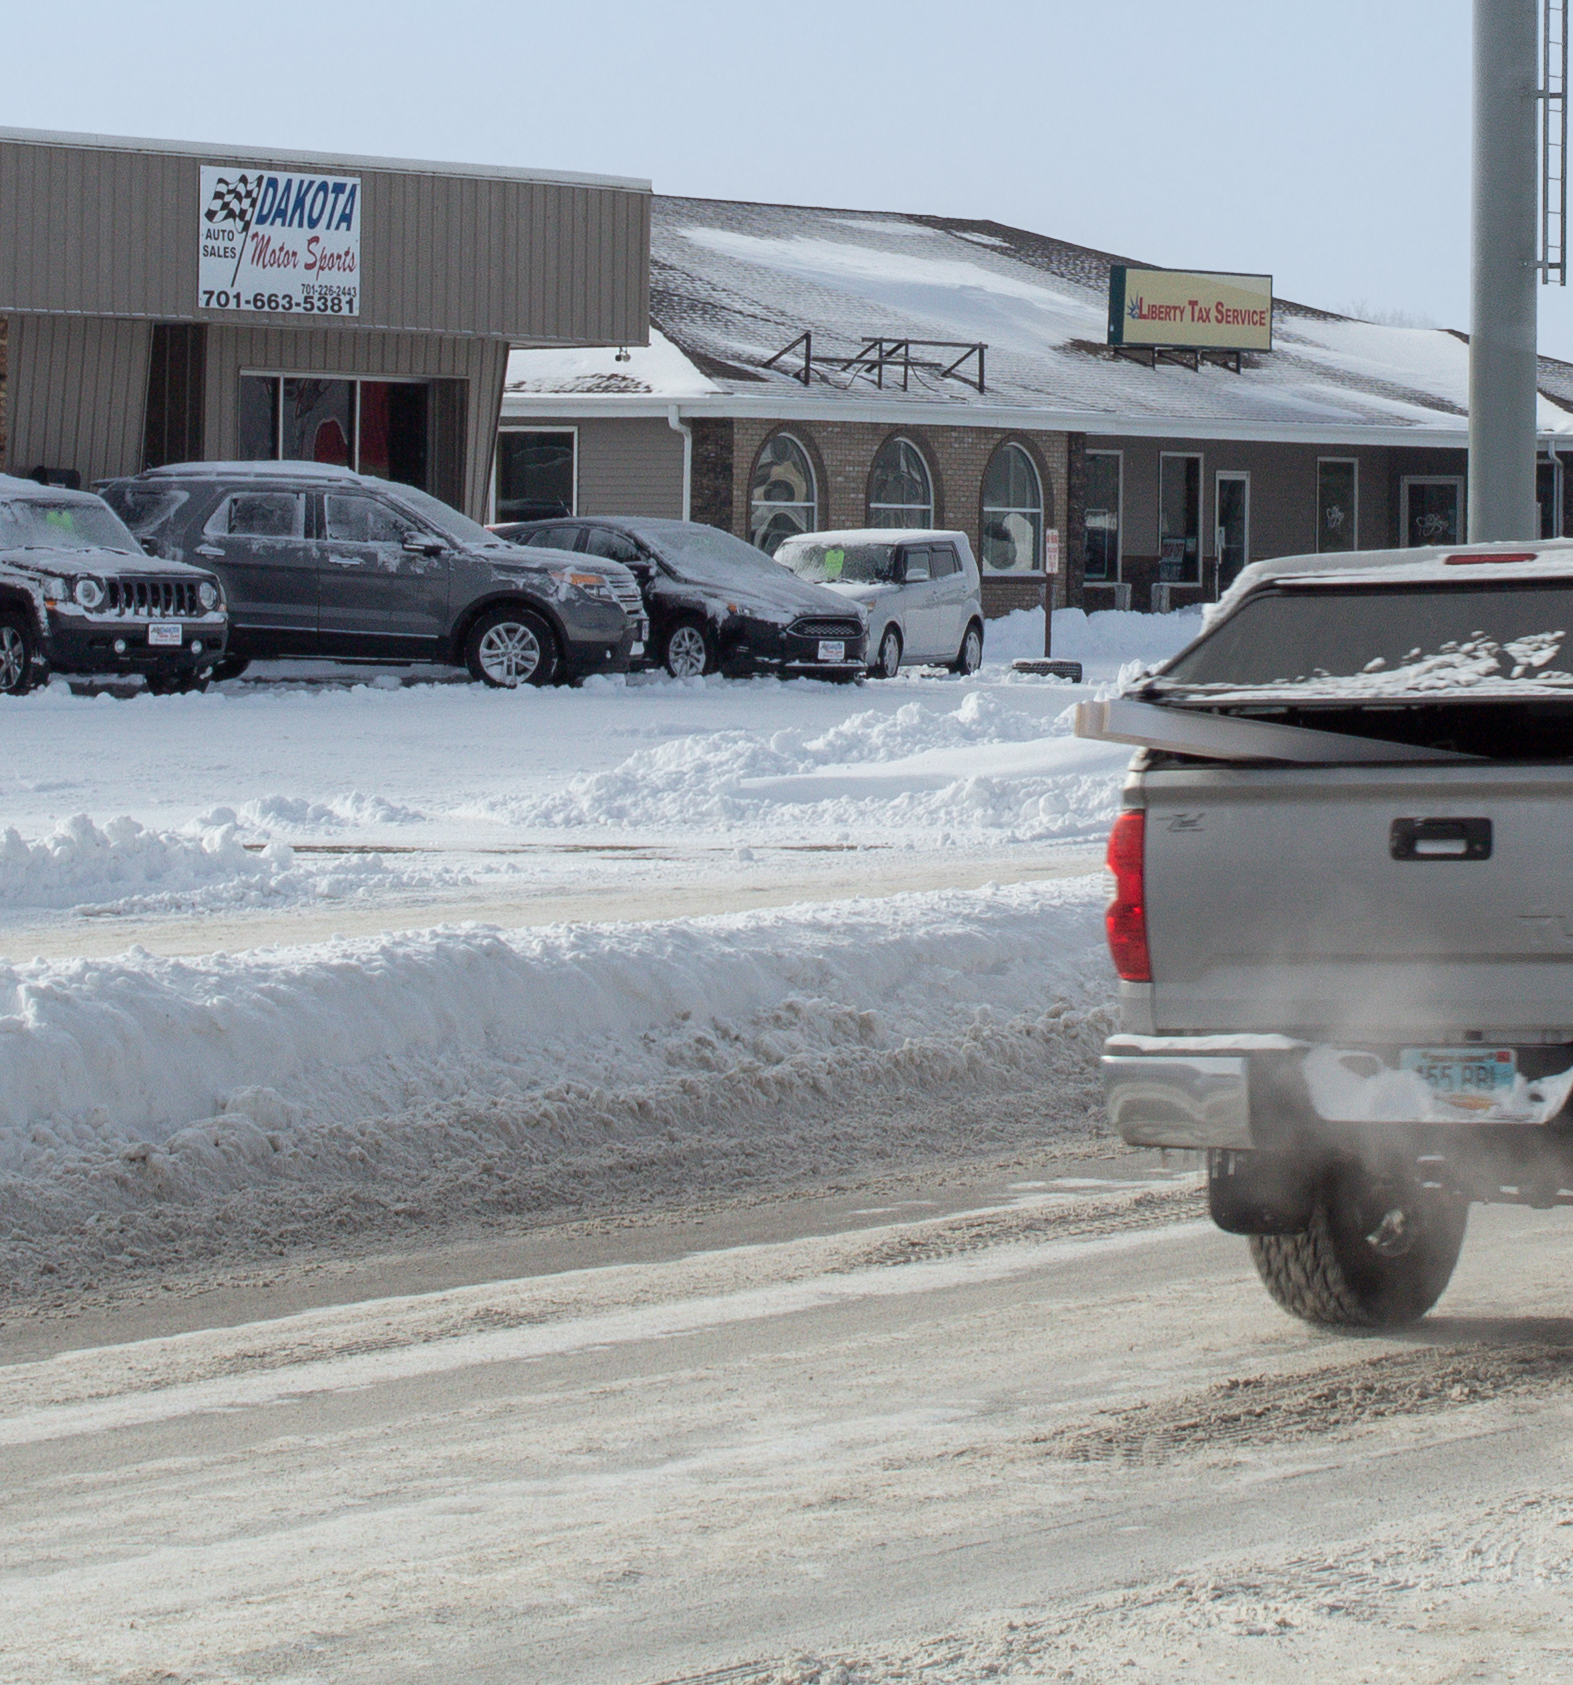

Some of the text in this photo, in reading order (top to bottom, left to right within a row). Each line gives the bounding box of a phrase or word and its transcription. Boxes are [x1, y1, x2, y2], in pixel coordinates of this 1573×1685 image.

[255, 176, 357, 232] DAKOTA
[205, 228, 235, 242] AUTO
[202, 245, 237, 259] SALES
[250, 231, 357, 281] Motor Sports
[202, 290, 354, 314] 701-663-5381
